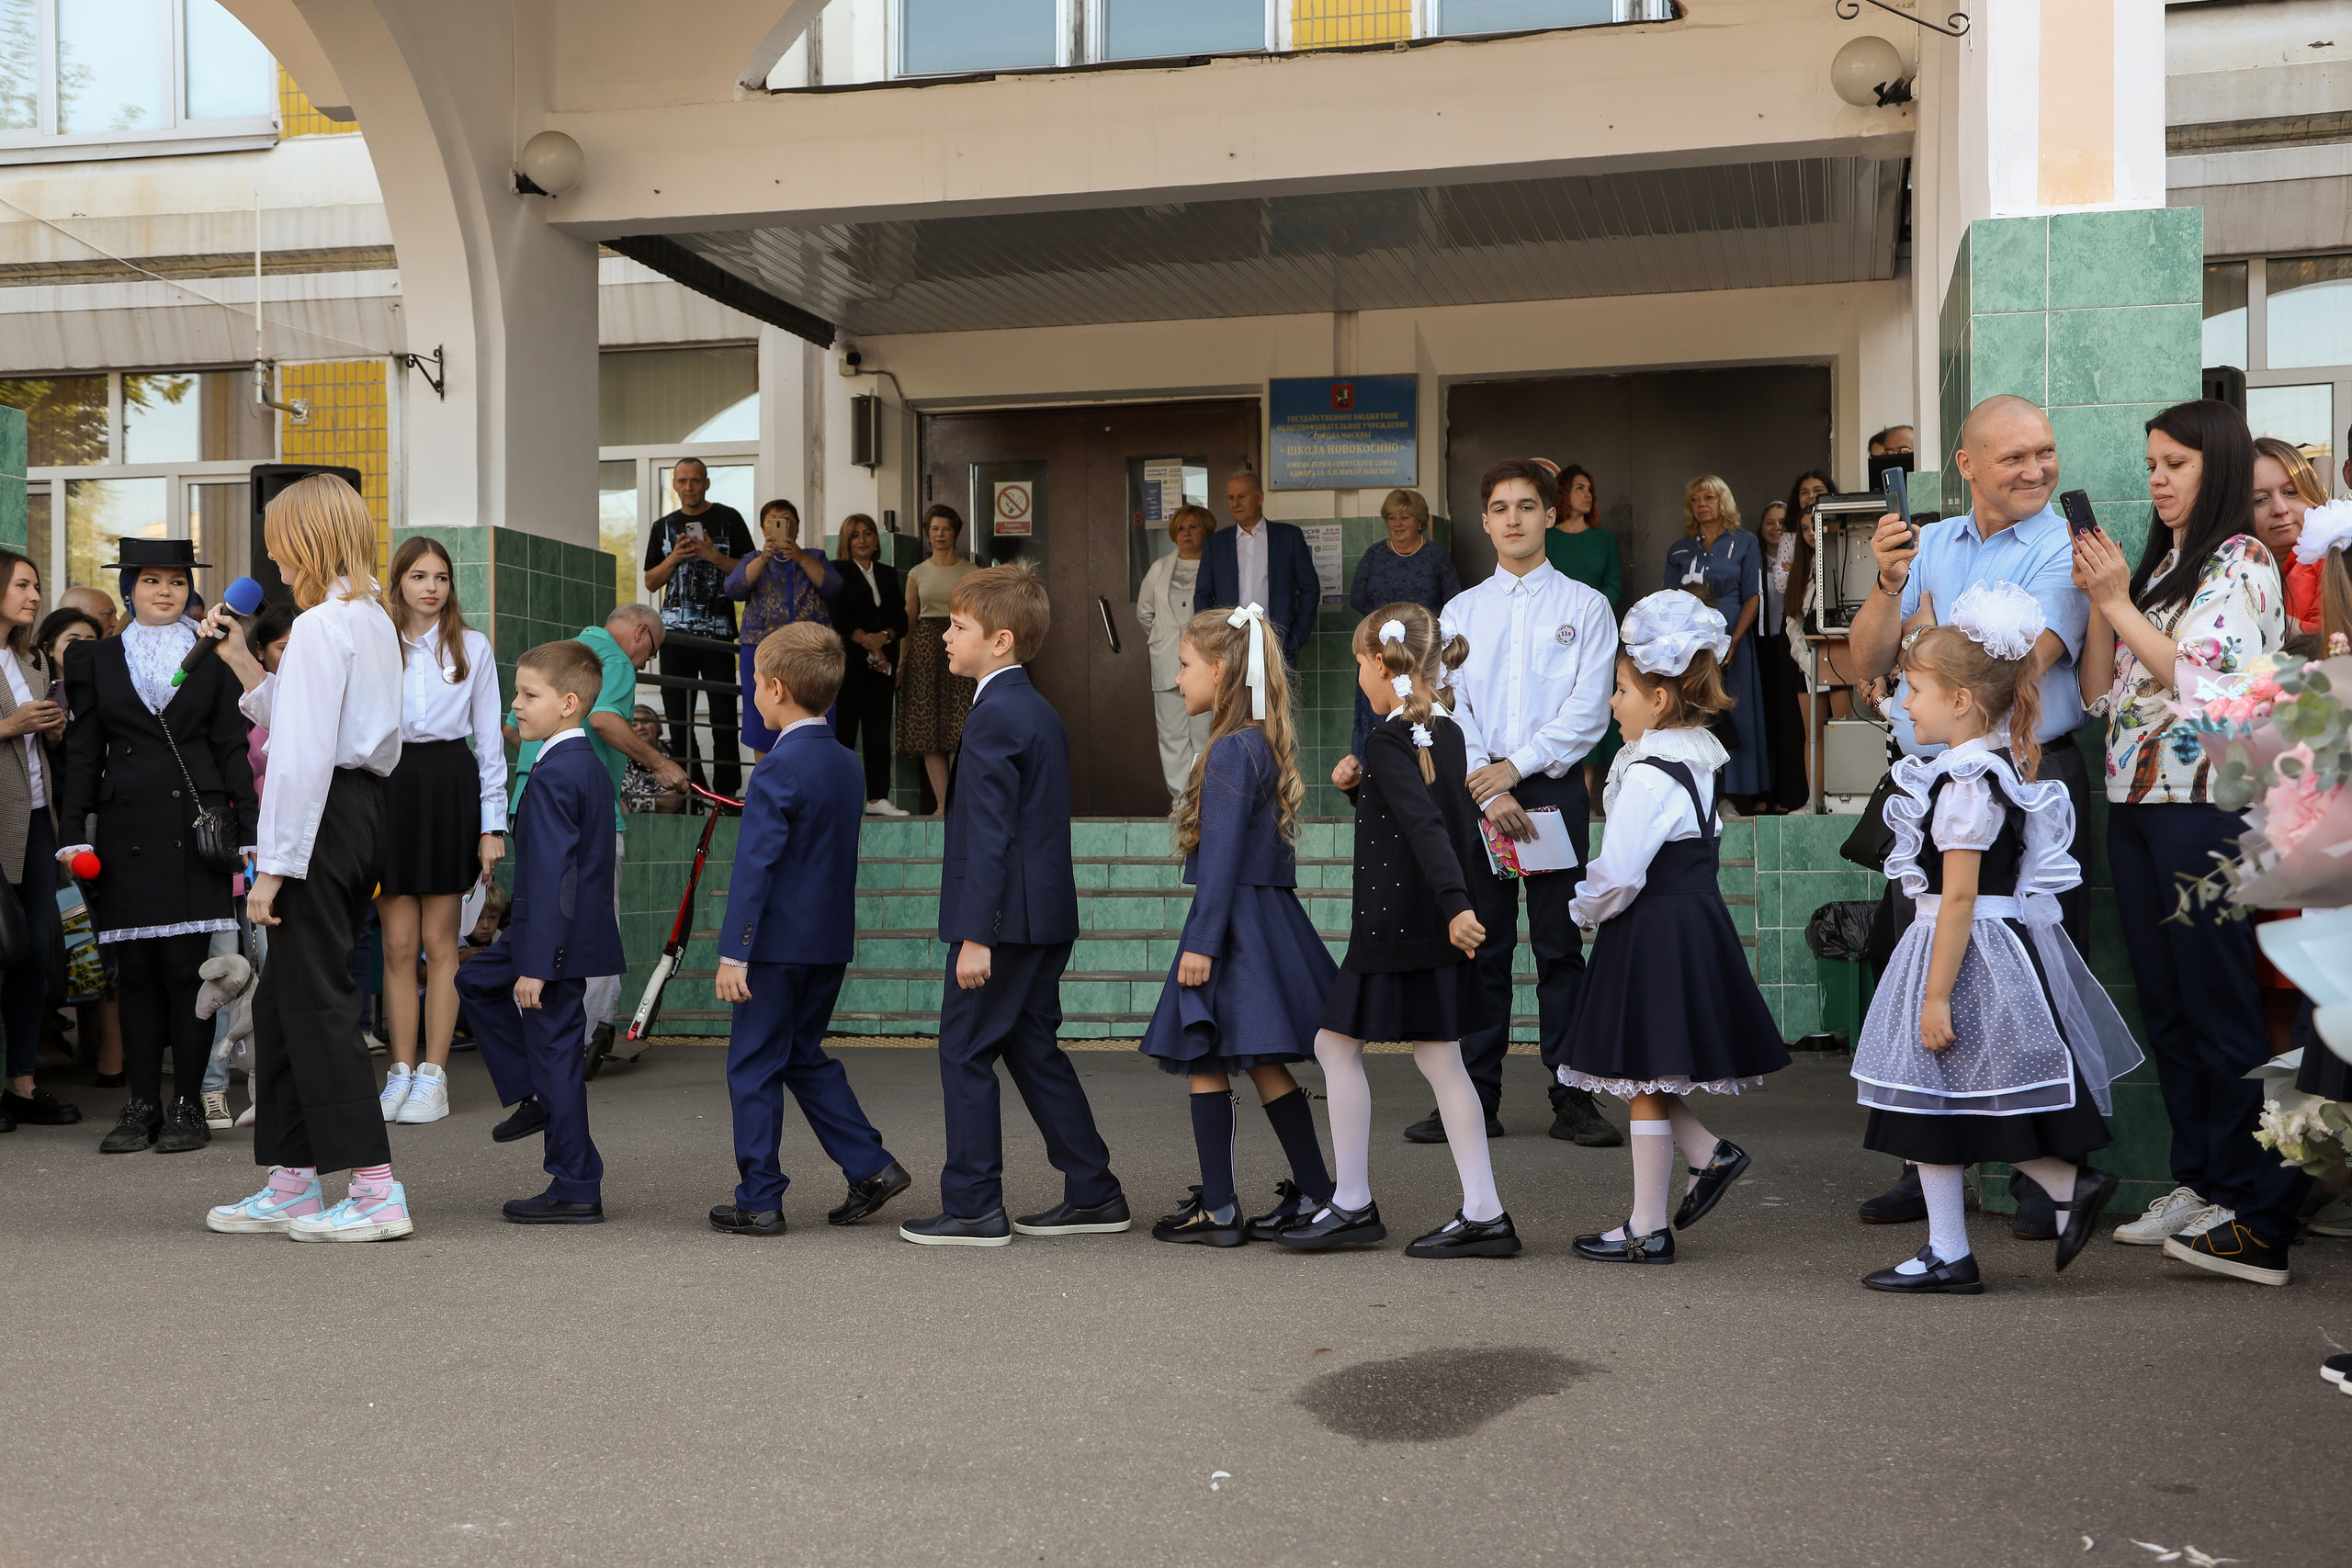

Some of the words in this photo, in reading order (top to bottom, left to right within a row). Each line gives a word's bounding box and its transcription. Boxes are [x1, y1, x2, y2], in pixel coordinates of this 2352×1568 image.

[1287, 413, 1352, 423] ГОСУДАРСТВЕННОЕ
[1353, 412, 1398, 421] БЮДЖЕТНОЕ
[1277, 423, 1362, 432] ОБЩЕОБРАЗОВАТЕЛЬНОЕ
[1363, 421, 1408, 429] УЧРЕЖДЕНИЕ
[1314, 432, 1340, 440] ГОРОДА
[1290, 469, 1325, 478] АДМИРАЛА
